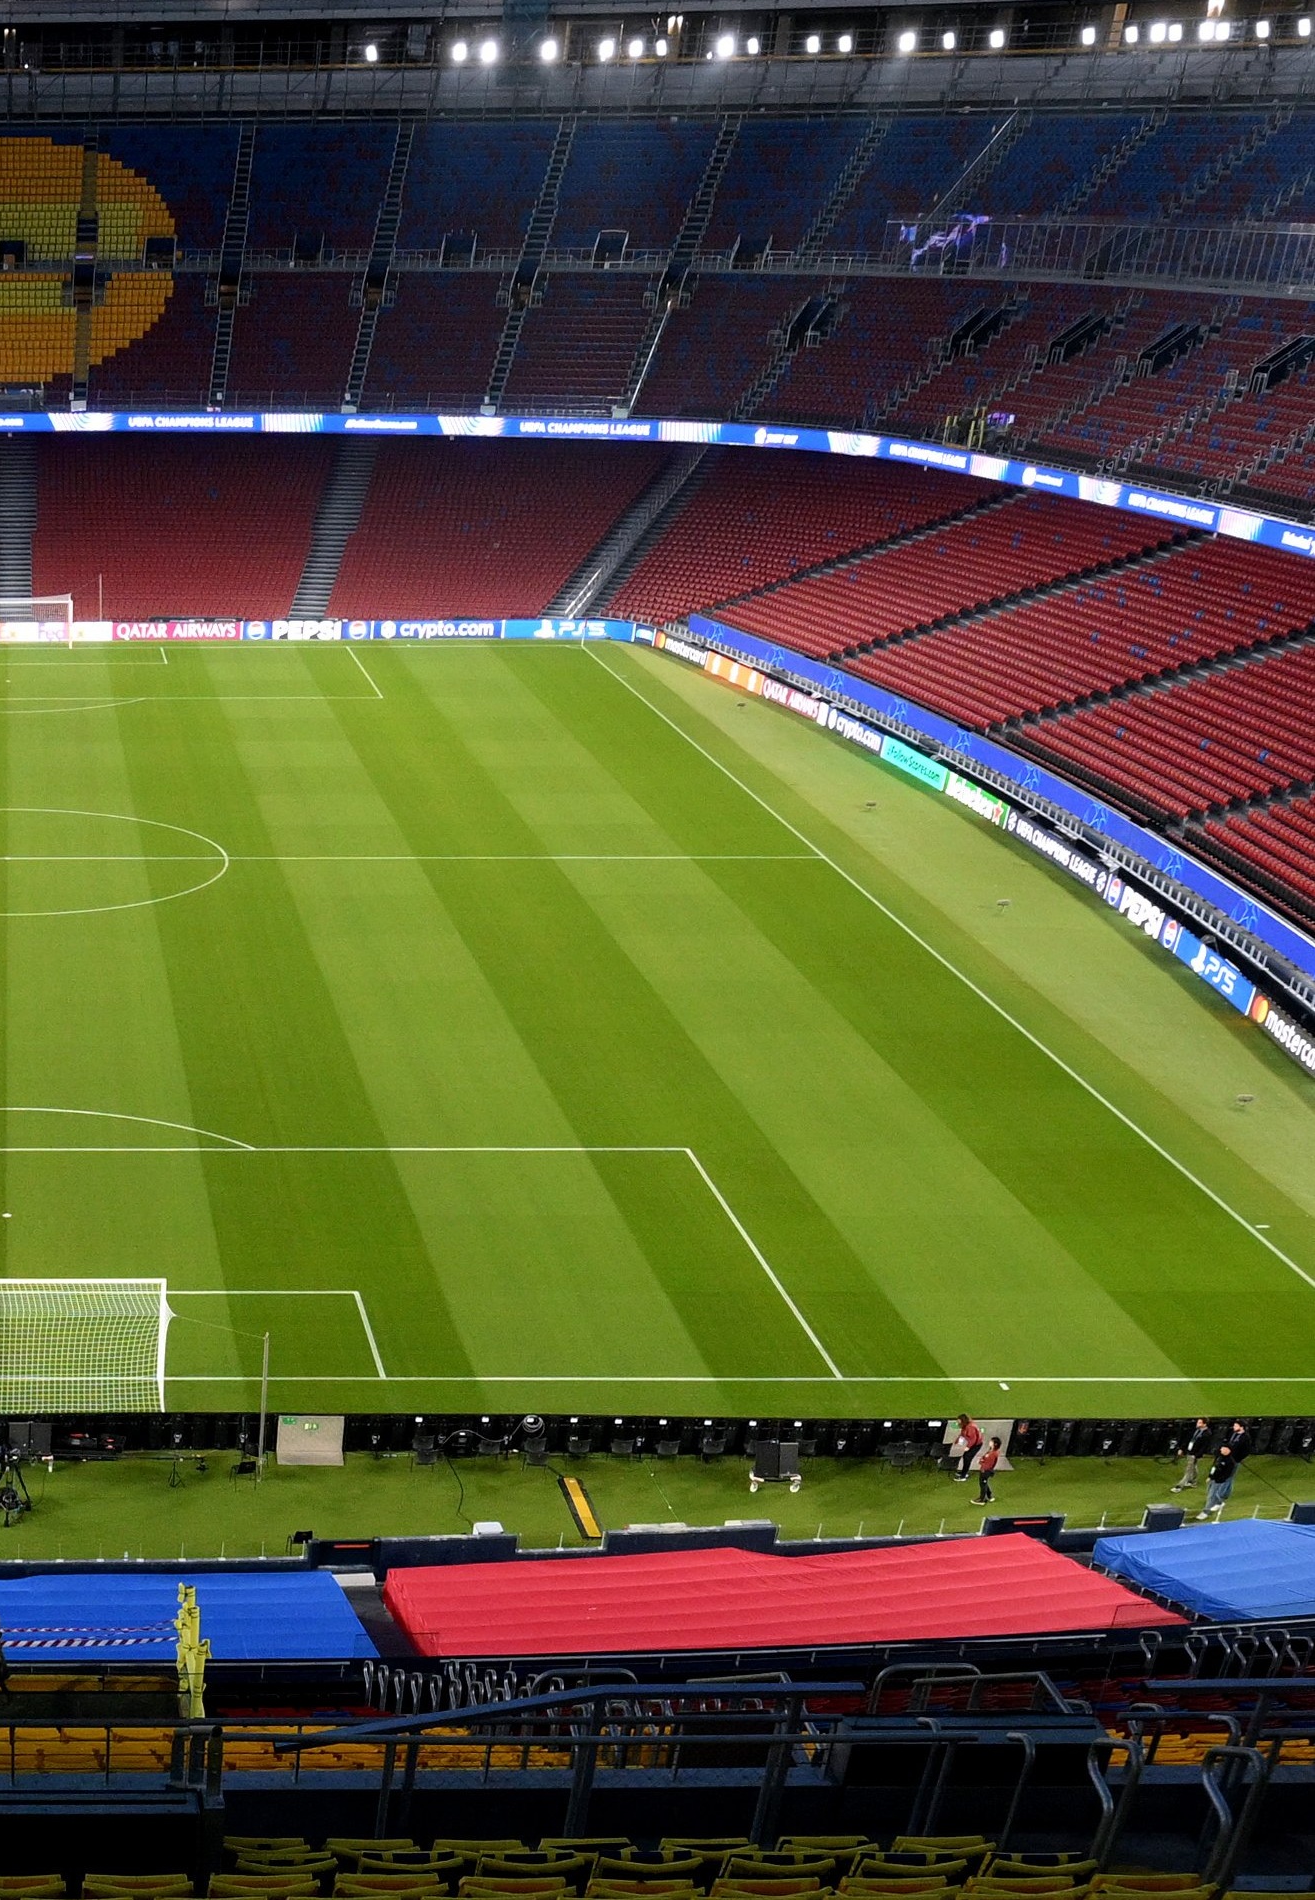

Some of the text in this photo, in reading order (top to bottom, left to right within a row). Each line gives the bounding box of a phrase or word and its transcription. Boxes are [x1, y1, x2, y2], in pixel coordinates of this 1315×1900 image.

[128, 416, 253, 427] UEFA CHAMPIONS LEAGUE
[519, 422, 651, 436] UEFA CHAMPIONS LEAGUE
[116, 622, 236, 640] QATAR AIRWAYS
[272, 620, 342, 640] PEPSI
[400, 620, 494, 639] crypto.com
[558, 621, 607, 636] PS5
[665, 637, 708, 666] mastercard
[763, 679, 820, 719] QATAR AIRWAYS
[836, 716, 882, 752] crypto.com
[945, 770, 995, 820] Heineken
[1016, 818, 1098, 884] UEFA CHAMPIONS LEAGUE
[1119, 885, 1166, 940] PEPSI
[1204, 955, 1237, 995] PS5
